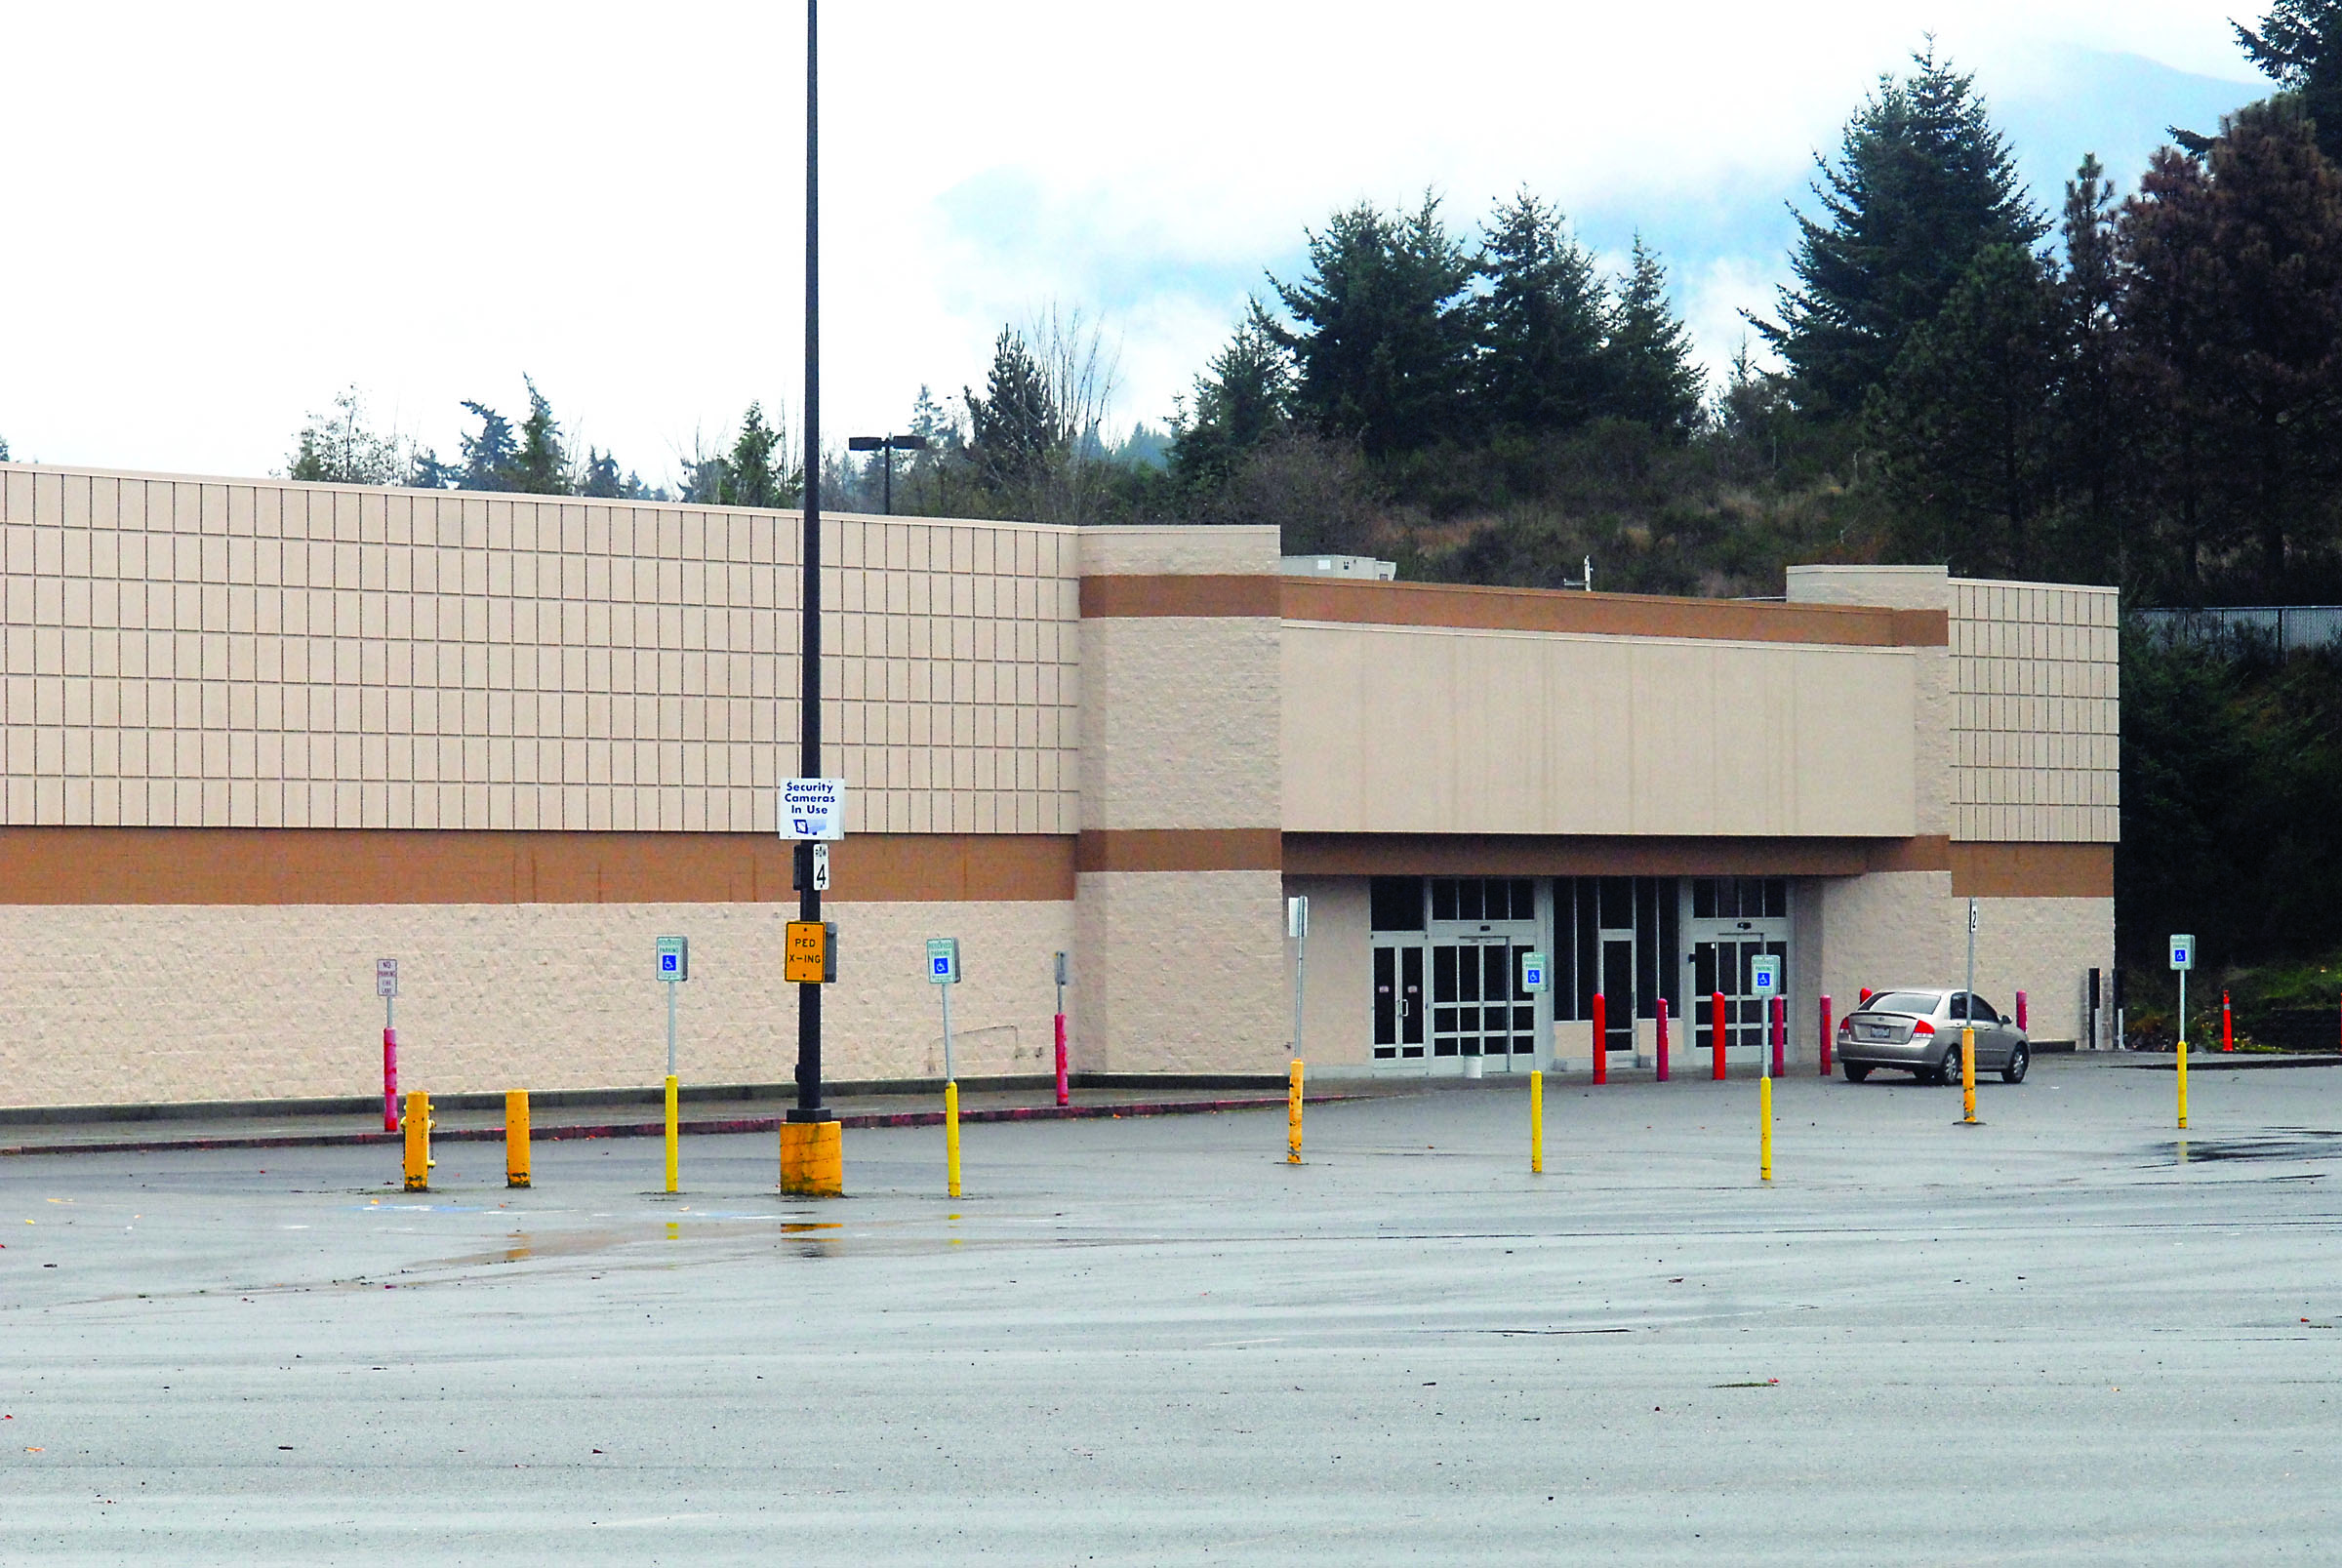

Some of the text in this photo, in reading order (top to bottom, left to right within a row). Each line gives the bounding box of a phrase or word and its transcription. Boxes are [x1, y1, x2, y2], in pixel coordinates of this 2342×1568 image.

[786, 782, 833, 794] Security
[785, 792, 835, 803] Cameras
[791, 804, 828, 815] In Use
[816, 864, 827, 885] 4
[794, 938, 816, 947] PED
[788, 953, 822, 964] X-ING
